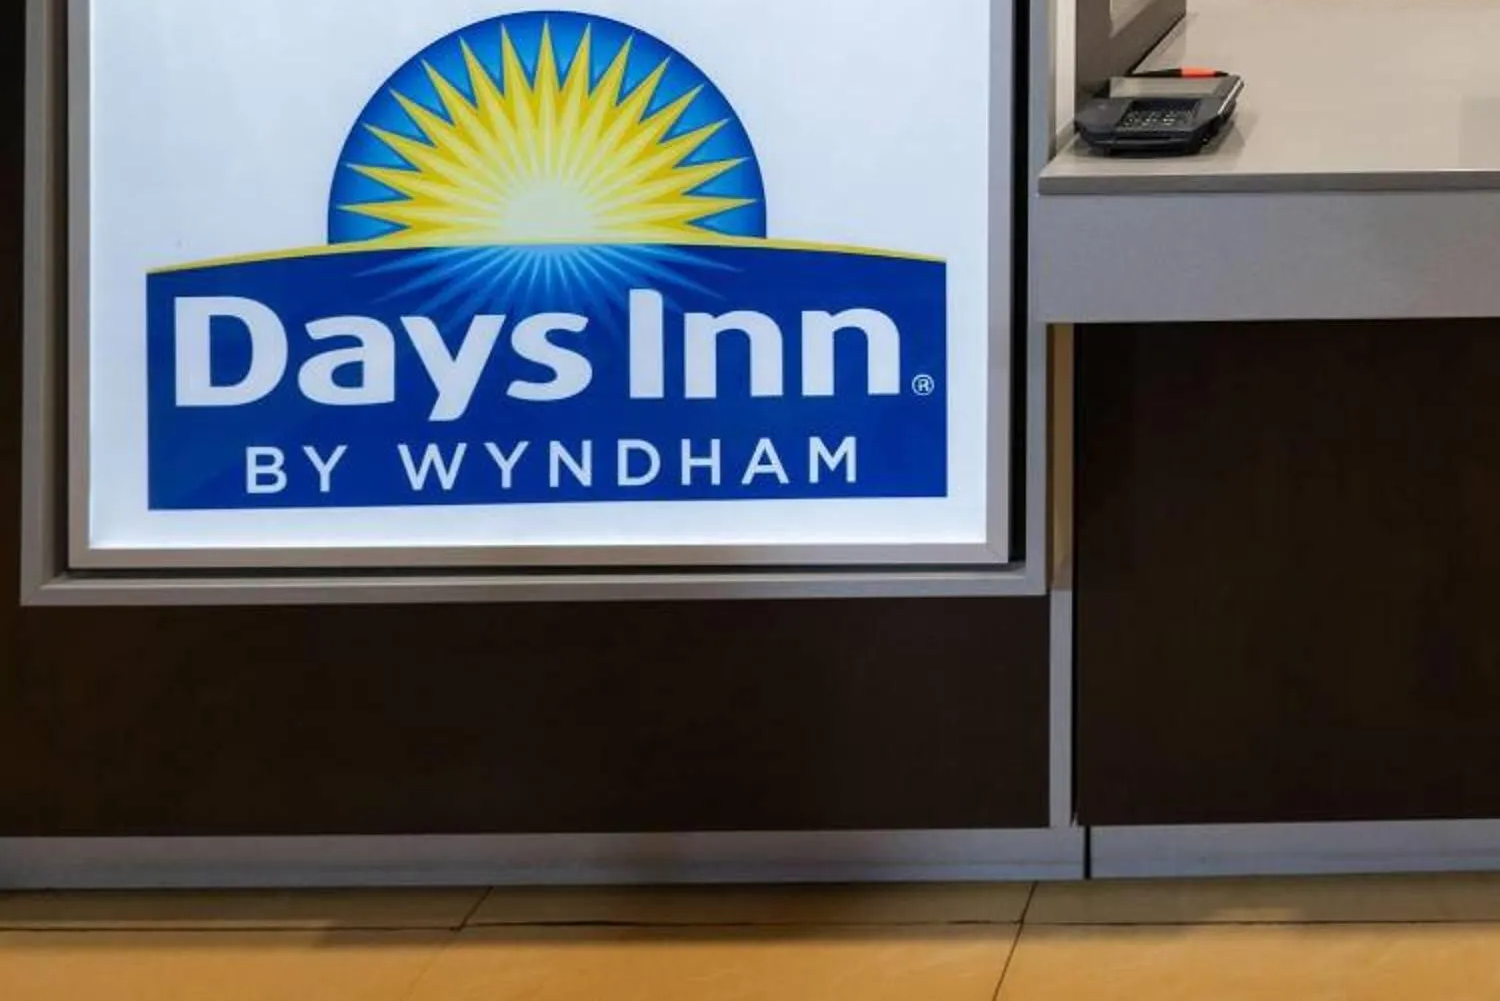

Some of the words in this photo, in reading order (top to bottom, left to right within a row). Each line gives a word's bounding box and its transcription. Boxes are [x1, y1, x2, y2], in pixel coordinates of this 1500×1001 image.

[175, 296, 592, 422] Days
[246, 446, 347, 494] BY
[398, 436, 857, 490] WYNDHAM
